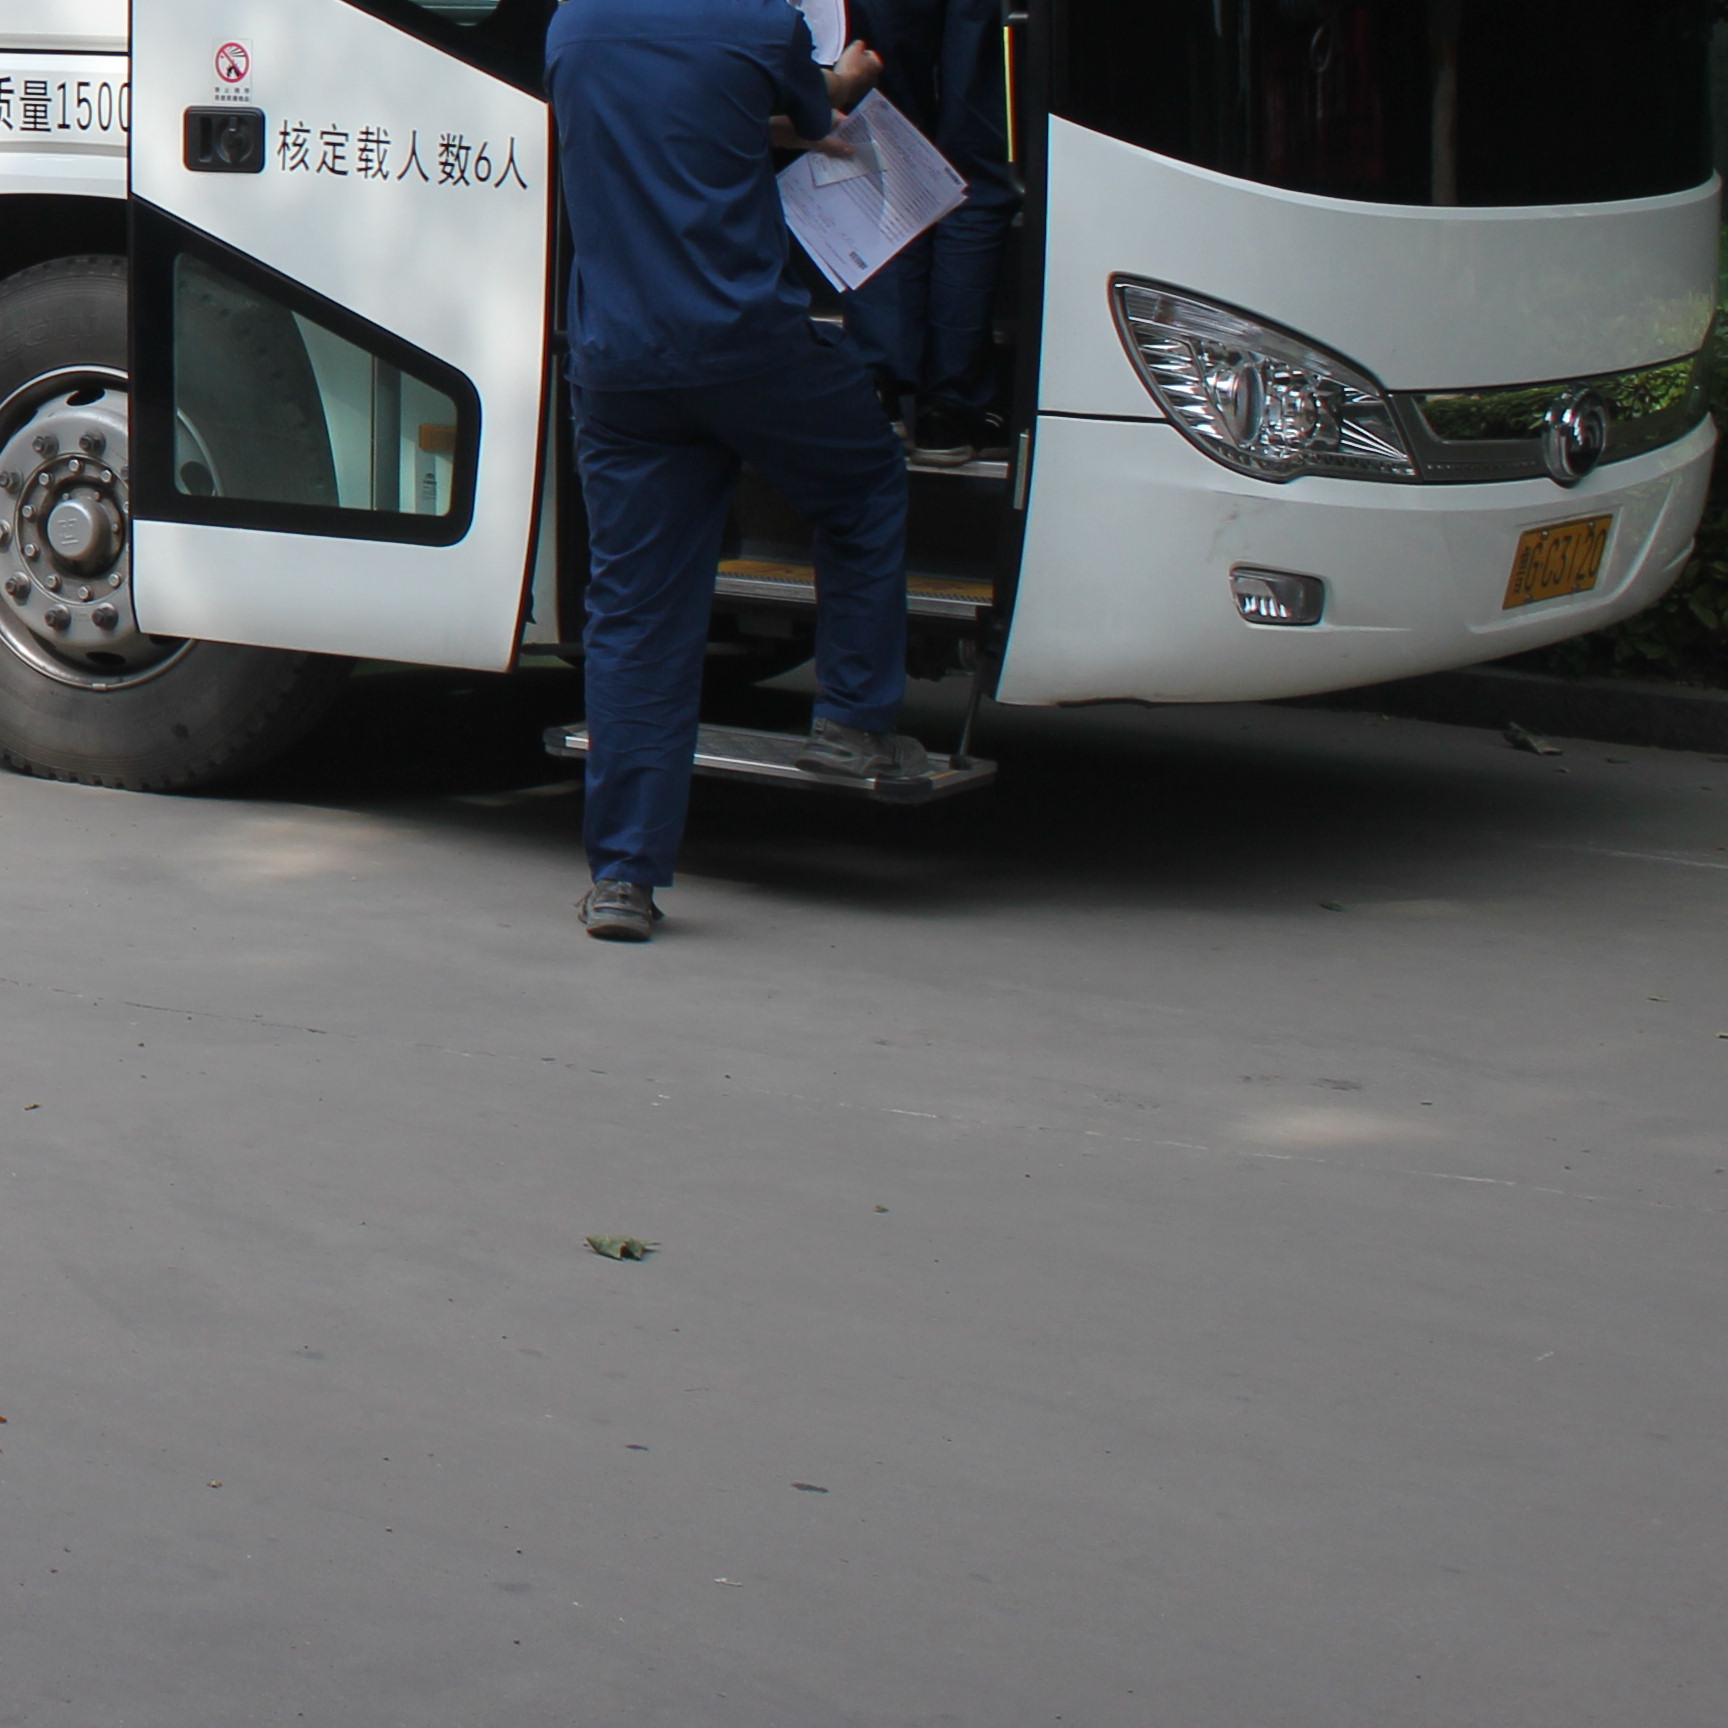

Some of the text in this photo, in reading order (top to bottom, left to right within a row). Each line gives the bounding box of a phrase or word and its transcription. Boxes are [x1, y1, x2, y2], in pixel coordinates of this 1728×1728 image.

[276, 119, 528, 190] 核定载人数6人
